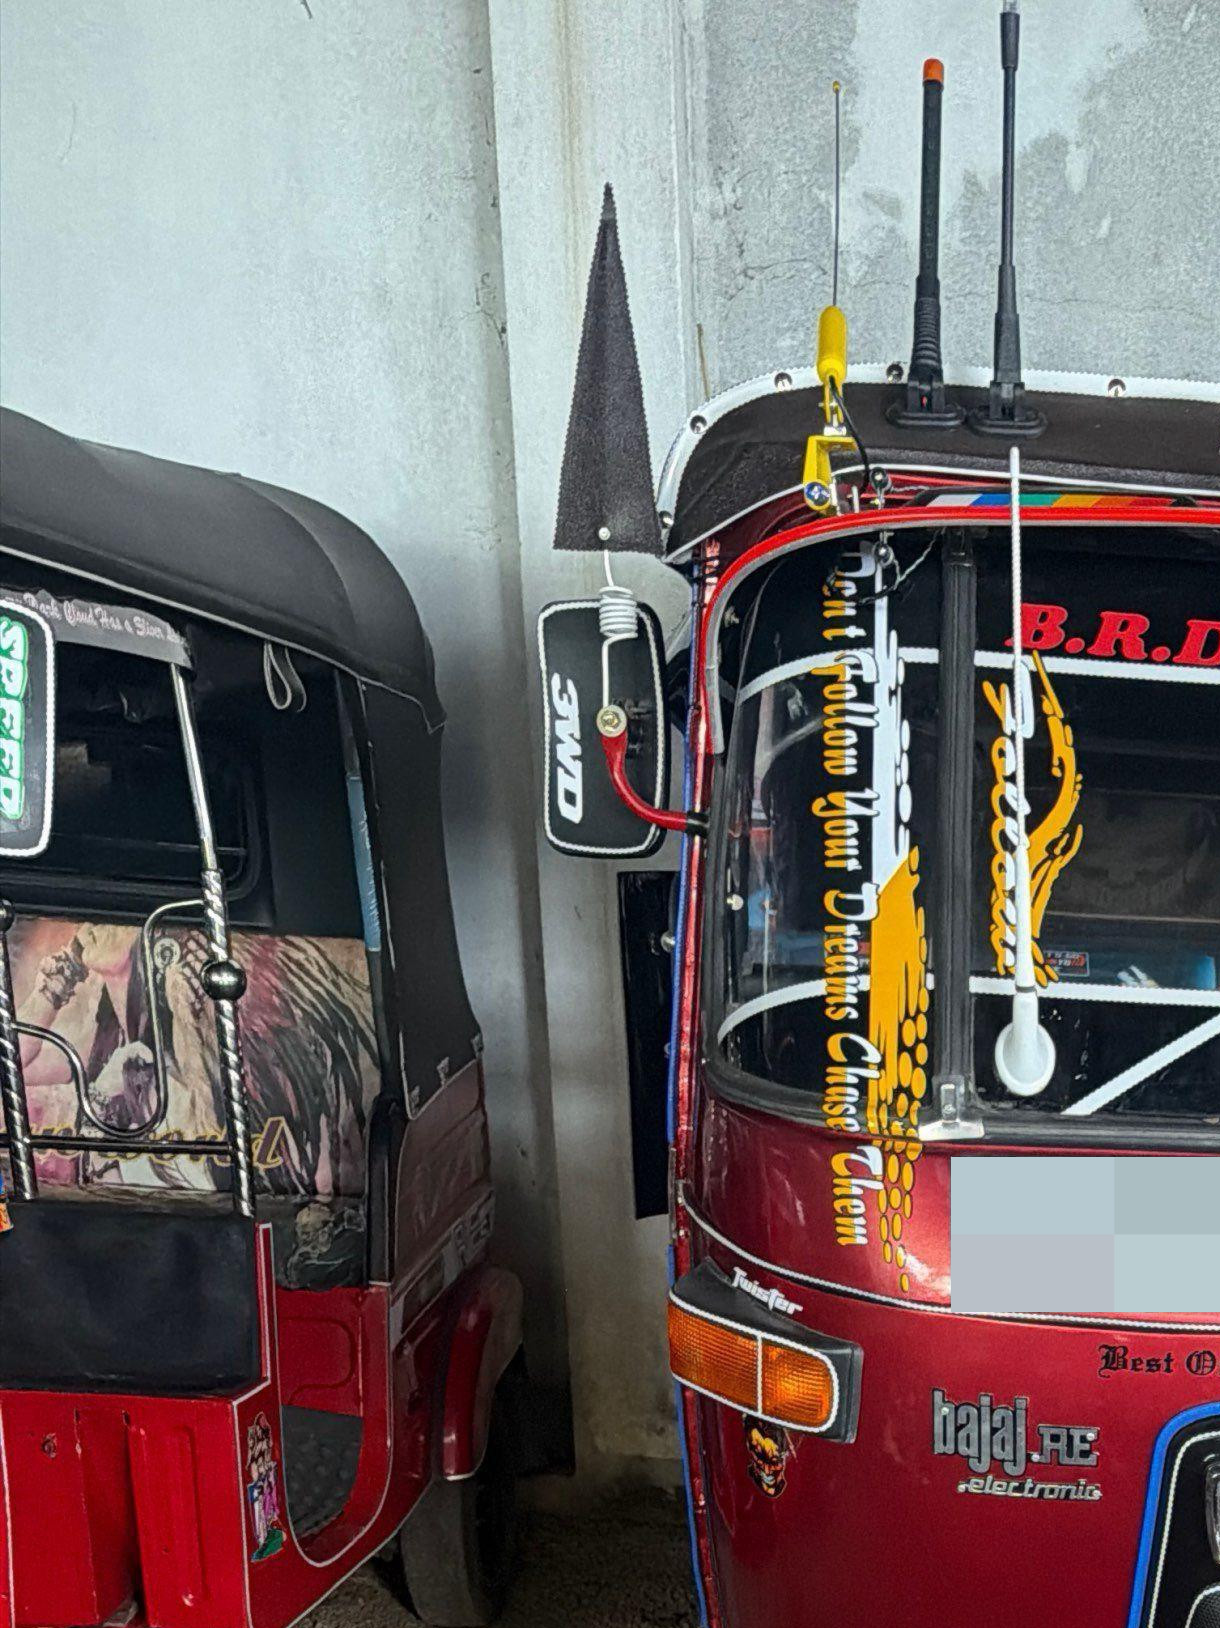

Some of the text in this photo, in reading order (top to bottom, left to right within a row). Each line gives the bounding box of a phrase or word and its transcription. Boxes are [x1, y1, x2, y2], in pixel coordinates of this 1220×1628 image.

[551, 672, 583, 824] 3WD
[811, 651, 879, 776] Follow
[811, 788, 880, 872] Your
[823, 882, 880, 1021] Dreams
[822, 1032, 882, 1133] Chase
[831, 1145, 885, 1246] Them
[731, 1266, 804, 1315] Twister
[1098, 1344, 1175, 1379] Best
[932, 1387, 1028, 1477] bajaj
[958, 1475, 1102, 1501] electronic
